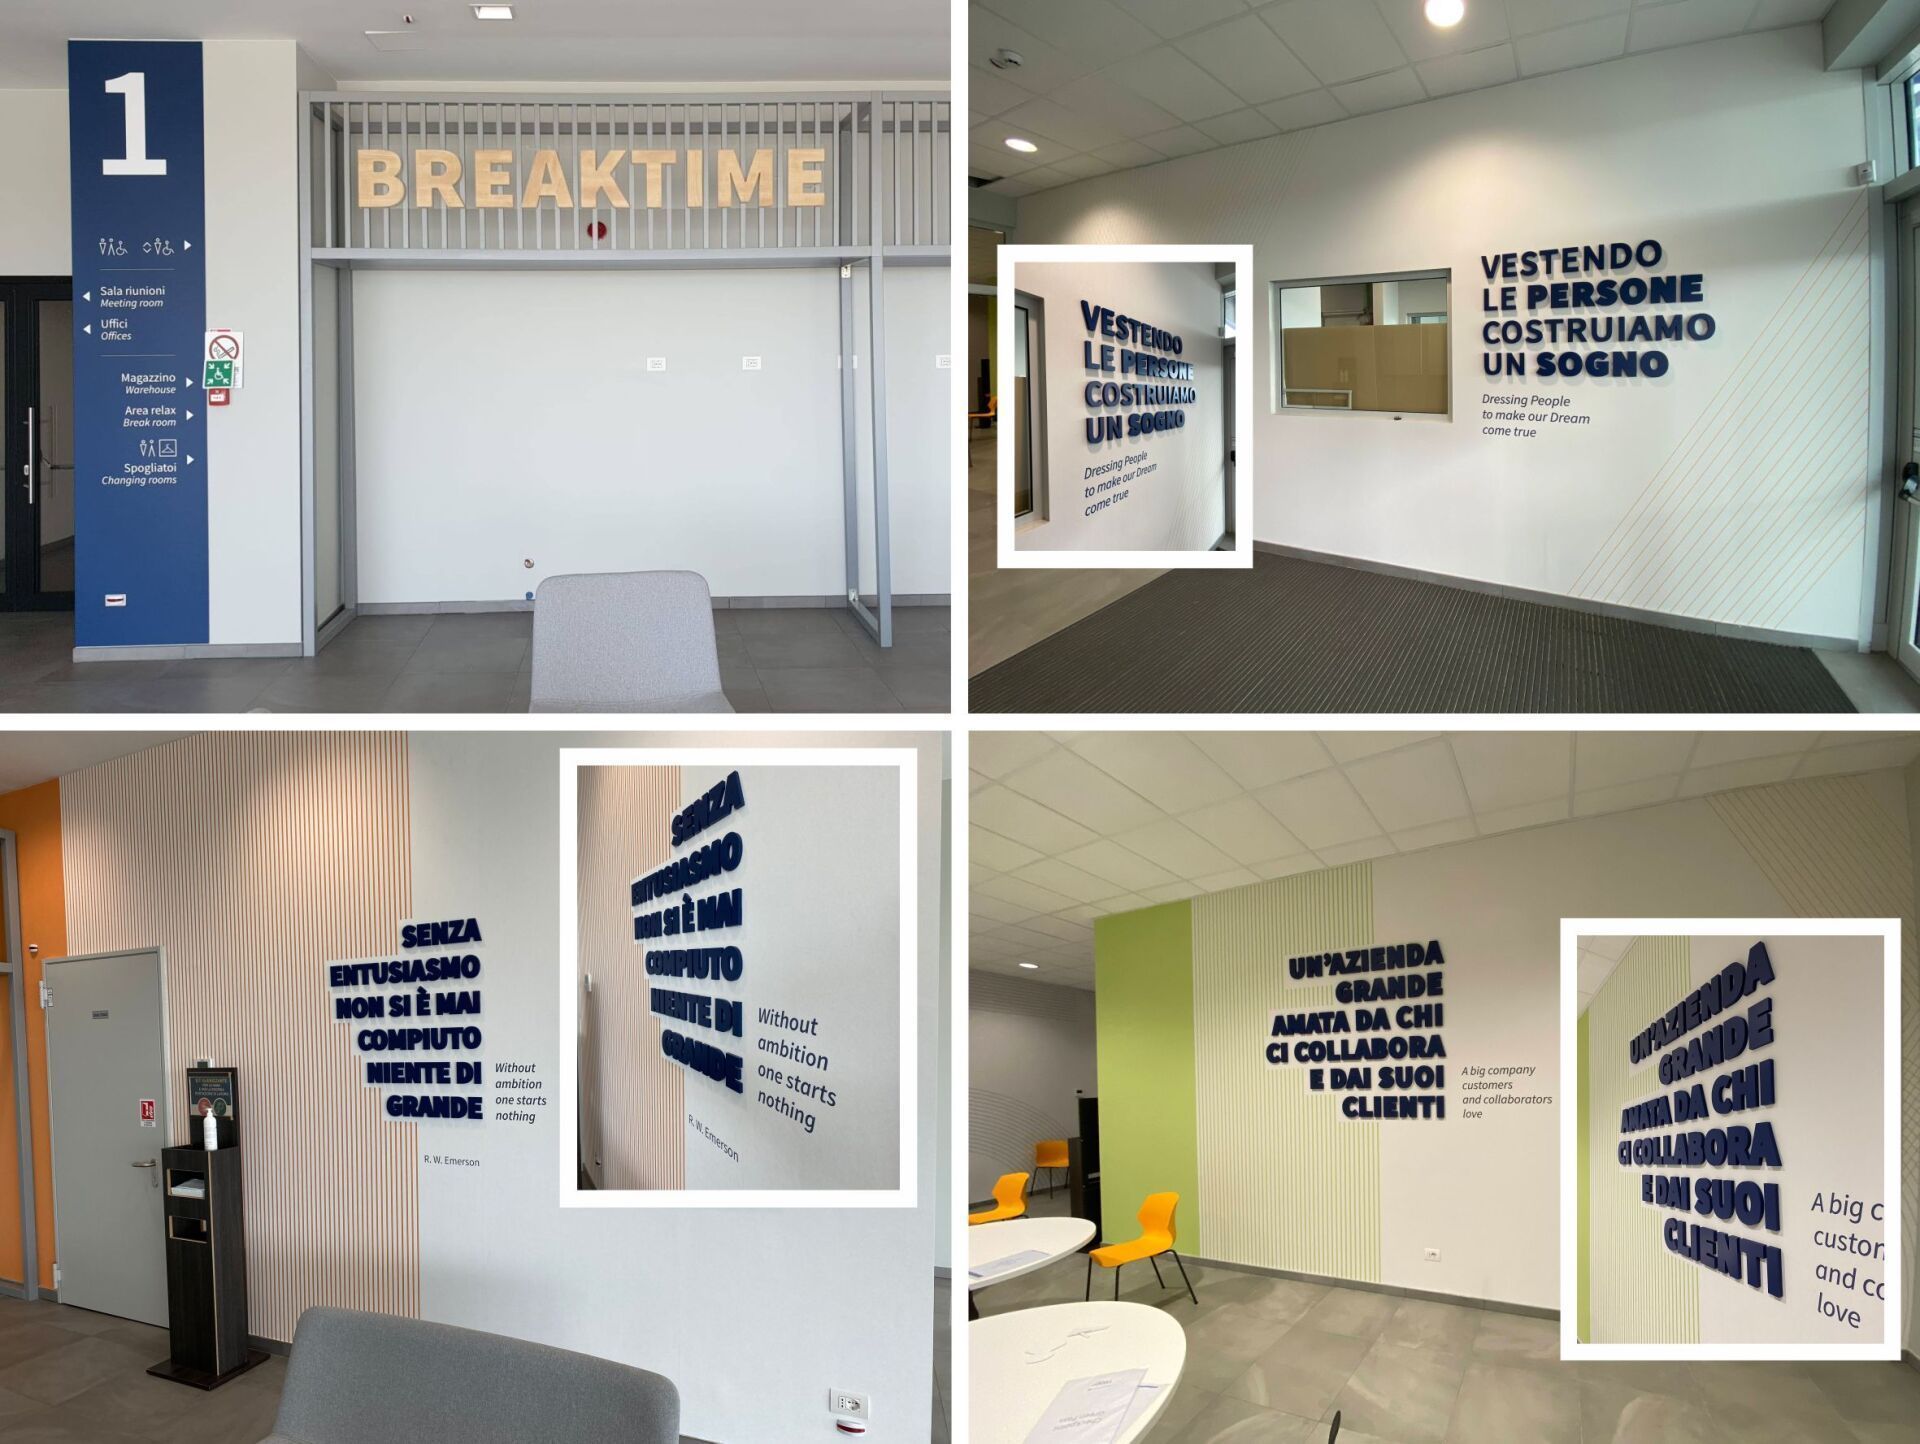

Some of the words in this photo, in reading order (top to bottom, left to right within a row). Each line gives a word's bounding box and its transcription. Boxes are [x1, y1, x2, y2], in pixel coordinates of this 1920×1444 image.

[103, 72, 167, 175] 1
[357, 148, 826, 209] BREAKTIME
[1481, 239, 1663, 279] VESTENDO
[100, 286, 123, 296] Sala
[125, 286, 166, 296] riunioni
[100, 299, 137, 309] Meeting
[1483, 286, 1518, 312] LE
[1527, 274, 1704, 310] PERSONE
[101, 318, 128, 328] Uffici
[101, 331, 132, 341] Offices
[1080, 300, 1183, 355] VESTENDO
[1482, 313, 1716, 345] COSTRUIAMO
[1084, 340, 1116, 372] LE
[1121, 349, 1194, 381] PERSONE
[1483, 352, 1526, 376] UN
[1536, 350, 1669, 378] SOGNO
[121, 373, 176, 385] Magazzino
[125, 386, 177, 394] Warehouse
[1084, 380, 1197, 408] COSTRUIAMO
[125, 406, 149, 415] Area
[151, 405, 176, 415] relax
[1482, 393, 1528, 408] Dressing
[1530, 394, 1571, 409] People
[123, 418, 150, 427] Break
[152, 419, 177, 427] room
[1086, 415, 1123, 444] UN
[1128, 409, 1186, 437] SOGNO
[1482, 409, 1493, 420] to
[1495, 409, 1526, 421] make
[1527, 412, 1548, 422] our
[1550, 411, 1590, 424] Dream
[1482, 425, 1512, 436] come
[1513, 426, 1537, 438] true
[124, 462, 177, 475] Spogliatoi
[1084, 457, 1123, 480] Dressing
[1124, 450, 1148, 467] People
[101, 476, 147, 486] Changing
[1084, 486, 1096, 499] to
[1097, 476, 1122, 495] make
[1122, 472, 1136, 483] our
[1136, 462, 1158, 478] Dream
[1084, 499, 1112, 517] come
[1112, 489, 1129, 505] true
[671, 770, 745, 847] SENZA
[631, 832, 743, 906] ENTUSIASMO
[634, 911, 662, 940] NON
[663, 906, 680, 936] SI
[682, 892, 696, 934] È
[697, 888, 742, 932] MAI
[401, 918, 482, 948] SENZA
[330, 954, 481, 987] ENTUSIASMO
[645, 946, 743, 982] COMPIUTO
[1289, 940, 1445, 980] UN'AZIENDA
[336, 996, 385, 1020] NON
[388, 994, 411, 1018] SI
[416, 986, 431, 1016] È
[436, 990, 481, 1016] MAI
[1335, 972, 1444, 1004] GRANDE
[1629, 941, 1775, 1064] UN'AZIENDA
[650, 988, 712, 1028] NIENTE
[714, 998, 742, 1038] DI
[758, 1008, 818, 1036] Without
[1271, 1010, 1351, 1036] AMATA
[1355, 1007, 1391, 1032] DA
[1396, 1003, 1444, 1029] CHI
[357, 1026, 482, 1051] COMPIUTO
[1266, 1042, 1289, 1064] CI
[1294, 1034, 1446, 1064] COLLABORA
[1658, 997, 1774, 1085] GRANDE
[495, 1062, 536, 1074] Without
[661, 1029, 744, 1094] GRANDE
[758, 1037, 829, 1071] ambition
[366, 1062, 451, 1084] NIENTE
[456, 1062, 482, 1084] DI
[495, 1078, 542, 1090] ambition
[758, 1064, 783, 1084] one
[786, 1074, 837, 1107] starts
[1310, 1068, 1324, 1090] E
[1330, 1066, 1372, 1090] DAI
[1378, 1064, 1445, 1090] SUOI
[1461, 1066, 1469, 1076] A
[1470, 1065, 1486, 1079] big
[1487, 1065, 1536, 1078] company
[1462, 1080, 1513, 1090] customers
[386, 1094, 484, 1120] GRANDE
[495, 1096, 514, 1106] one
[516, 1095, 547, 1106] starts
[1342, 1095, 1445, 1119] CLIENTI
[1462, 1094, 1482, 1105] and
[1483, 1094, 1553, 1105] collaborators
[1621, 1096, 1673, 1133] AMATA
[1674, 1083, 1709, 1123] DA
[1711, 1058, 1776, 1115] CHI
[495, 1110, 536, 1124] nothing
[758, 1090, 816, 1134] nothing
[1462, 1108, 1483, 1119] love
[688, 1114, 695, 1127] R.
[696, 1119, 704, 1134] W.
[704, 1127, 739, 1163] Emerson
[1617, 1140, 1632, 1166] CI
[1632, 1121, 1783, 1167] COLLABORA
[424, 1155, 432, 1164] R.
[433, 1156, 442, 1164] W.
[444, 1156, 480, 1167] Emerson
[1642, 1174, 1654, 1202] E
[1656, 1175, 1691, 1211] DAI
[1694, 1177, 1781, 1232] SUOI
[1811, 1192, 1824, 1213] A
[1829, 1192, 1864, 1224] big
[1663, 1217, 1784, 1298] CLIENTI
[1815, 1264, 1857, 1290] and
[1817, 1292, 1861, 1329] love
